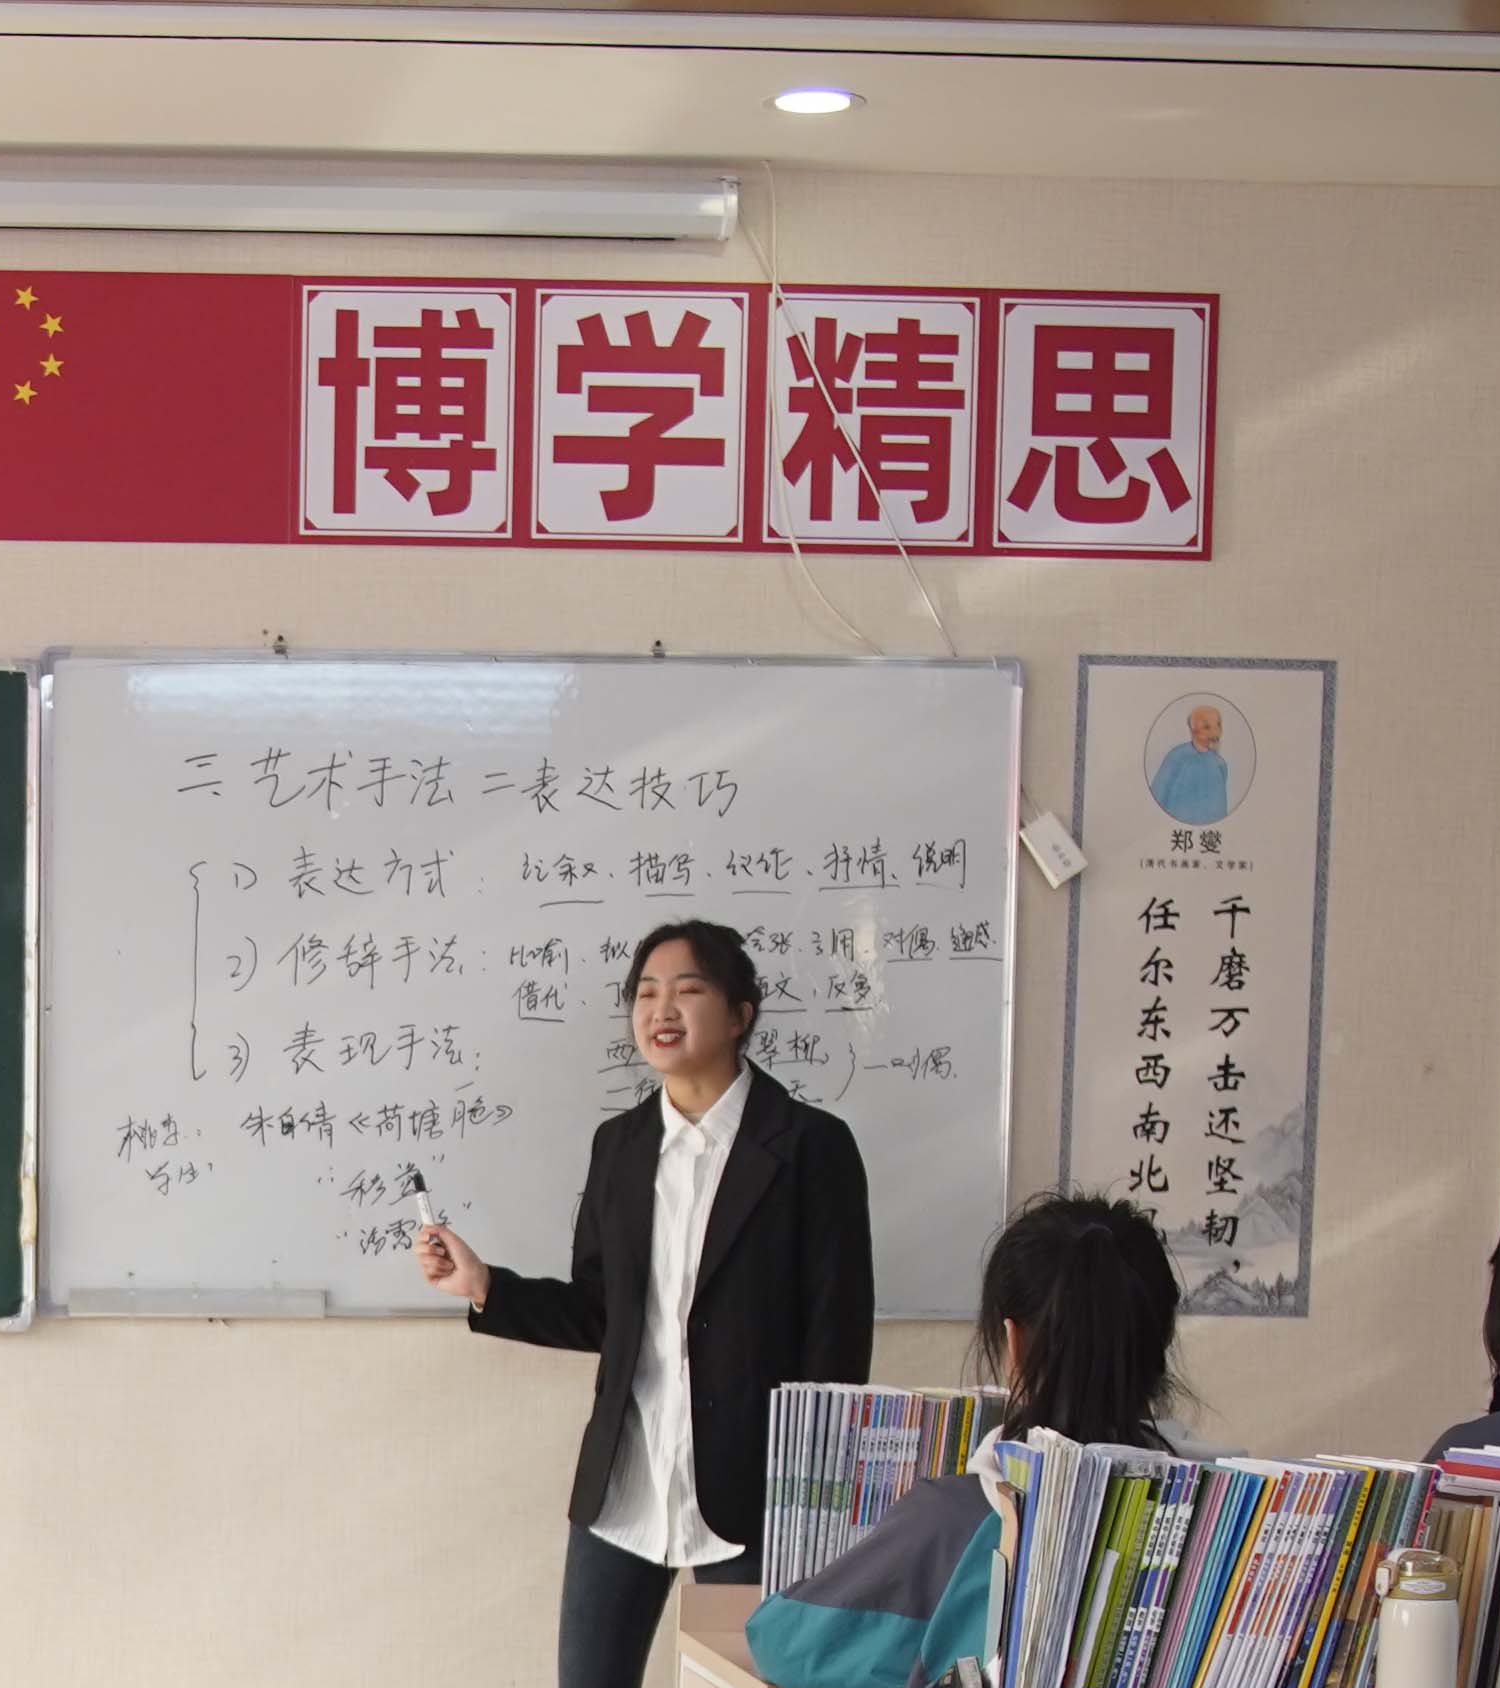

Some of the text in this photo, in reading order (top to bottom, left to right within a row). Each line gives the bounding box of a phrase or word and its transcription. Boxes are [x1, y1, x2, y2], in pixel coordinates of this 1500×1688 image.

[317, 306, 1193, 525] 博学精思
[1171, 829, 1222, 853] 郑燮
